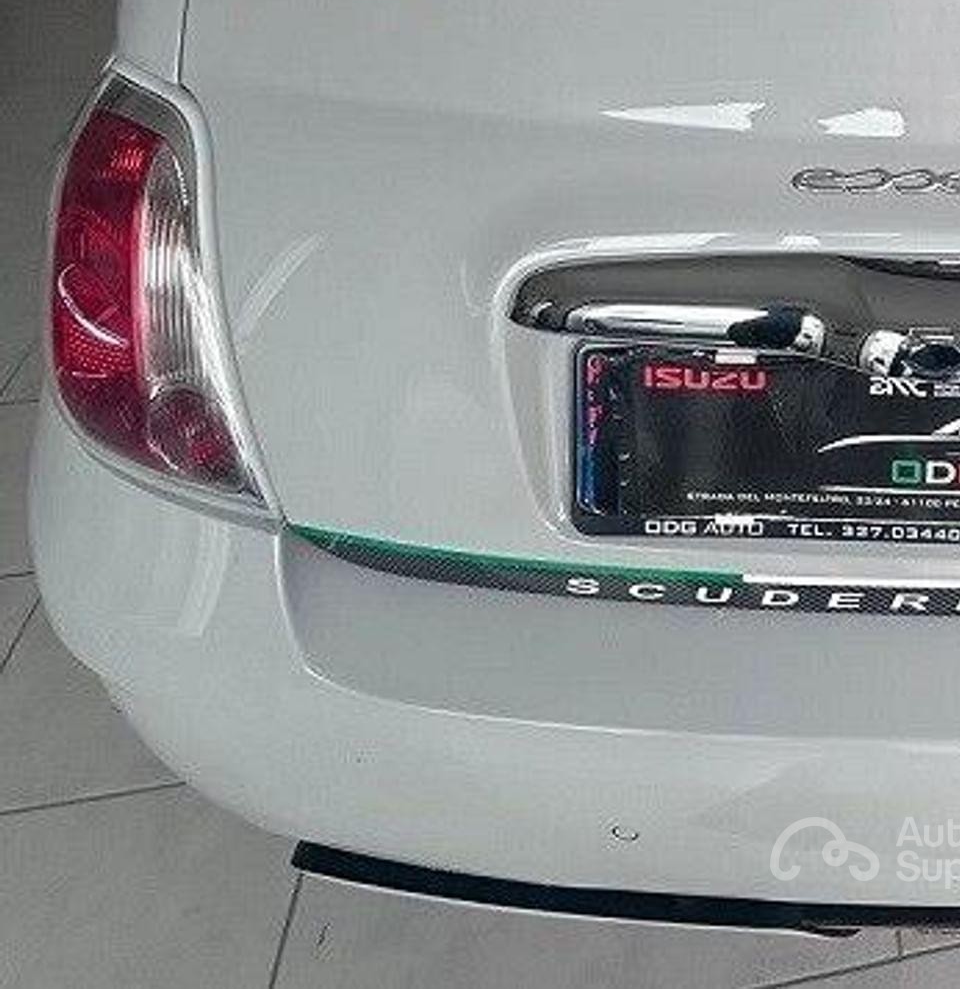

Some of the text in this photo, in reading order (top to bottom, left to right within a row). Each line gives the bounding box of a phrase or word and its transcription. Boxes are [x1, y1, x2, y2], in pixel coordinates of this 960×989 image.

[644, 365, 767, 390] ISUZU
[644, 519, 697, 535] ODG
[787, 522, 833, 537] TEL.
